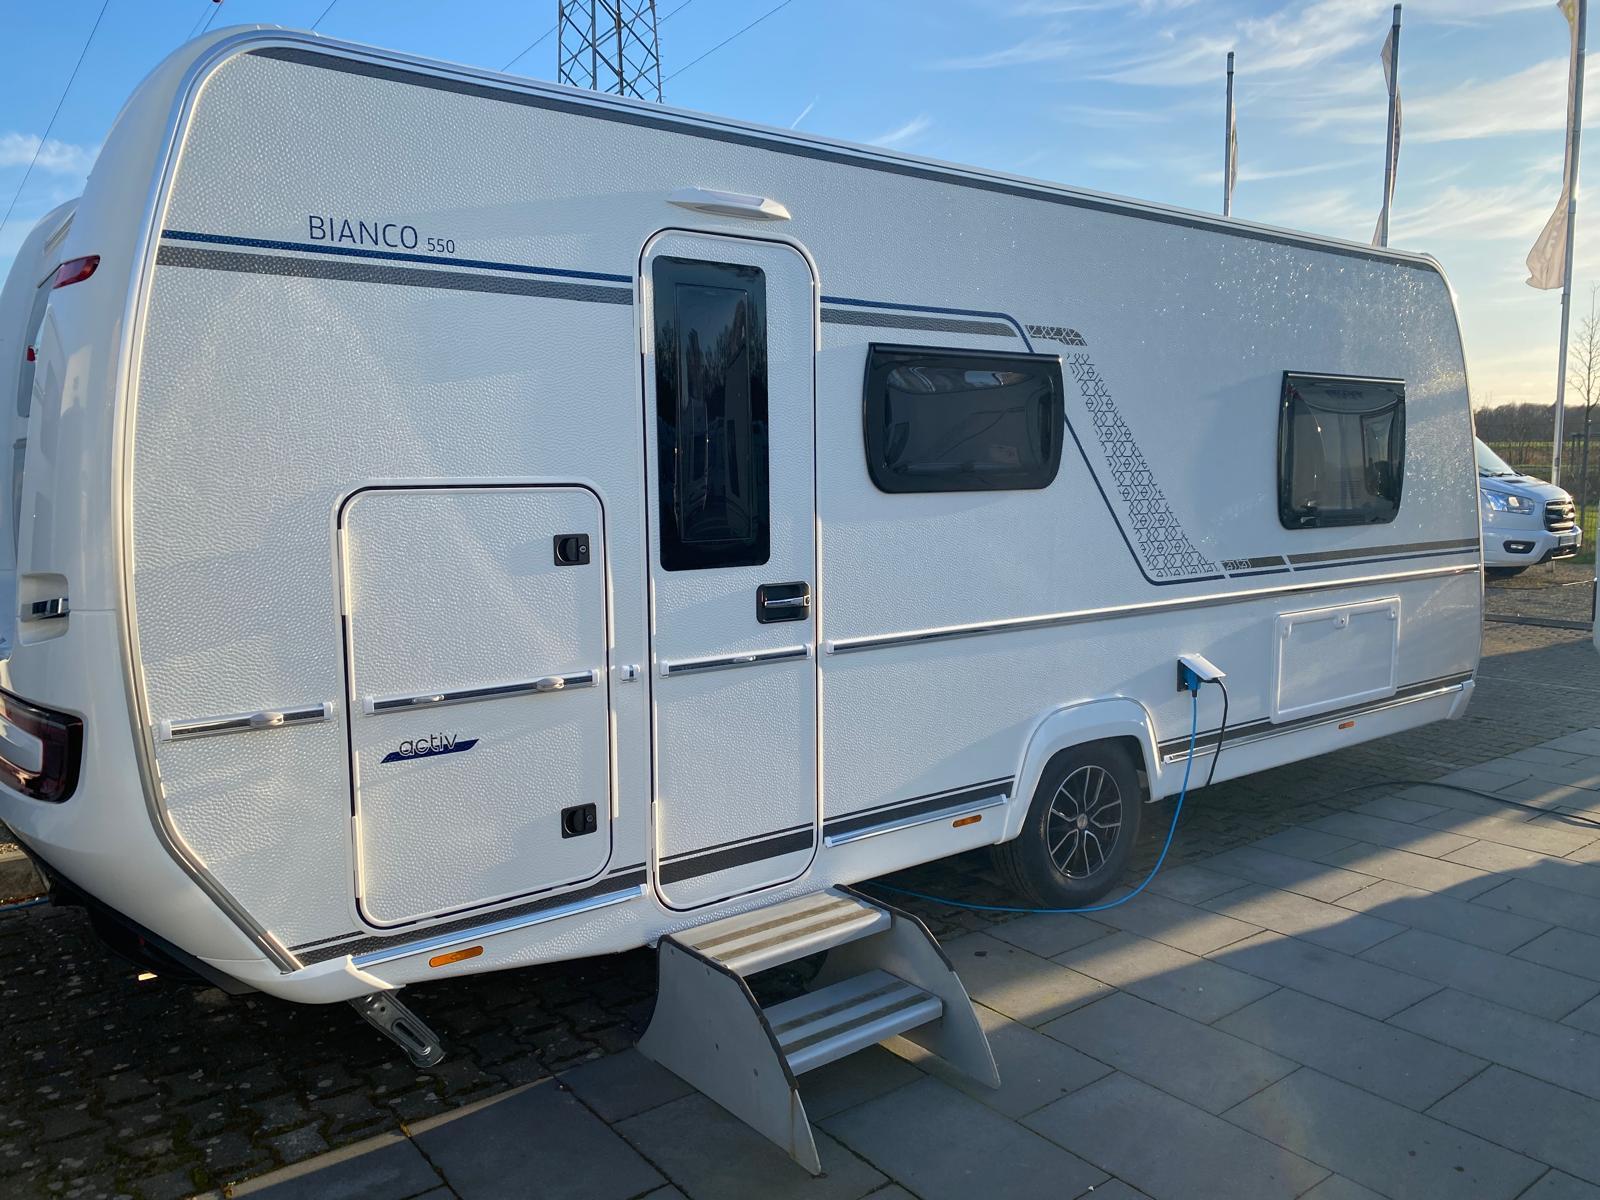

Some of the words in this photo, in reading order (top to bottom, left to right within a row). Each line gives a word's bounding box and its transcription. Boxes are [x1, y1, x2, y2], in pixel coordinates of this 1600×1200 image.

[309, 215, 418, 249] BIANCO
[427, 237, 455, 254] 550
[399, 732, 458, 756] activ
